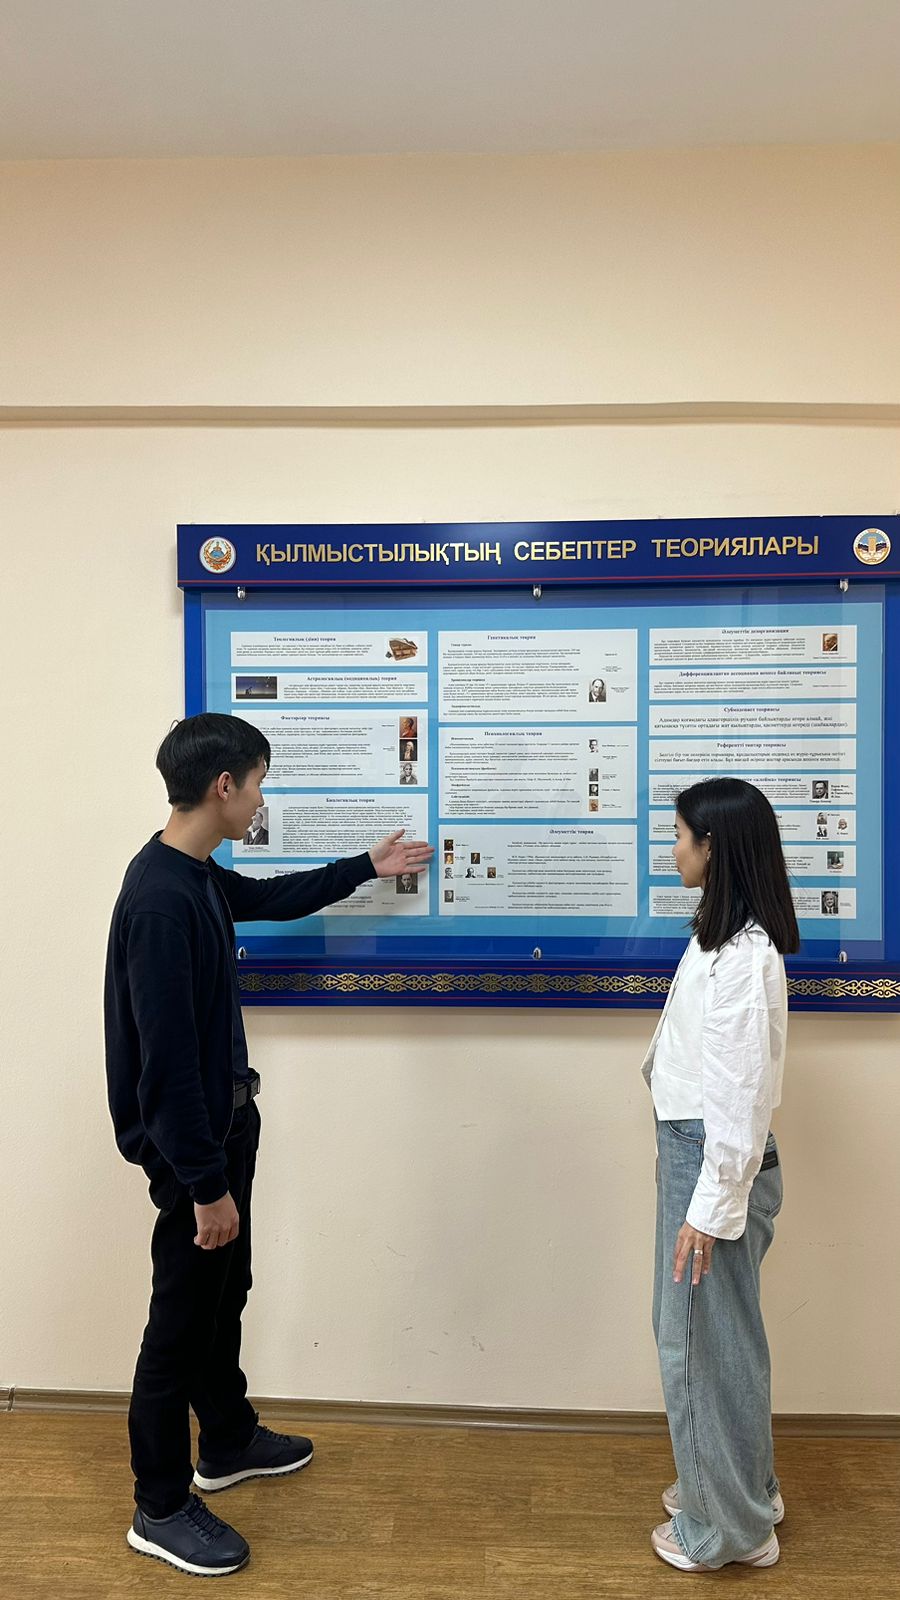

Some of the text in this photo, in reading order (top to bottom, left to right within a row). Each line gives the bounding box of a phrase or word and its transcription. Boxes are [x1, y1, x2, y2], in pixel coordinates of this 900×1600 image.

[256, 536, 820, 565] ҚЫЛМЫСТЫЛЫҚТЫҢ СЕБЕПТЕР ТЕОРИЯЛАРЫ
